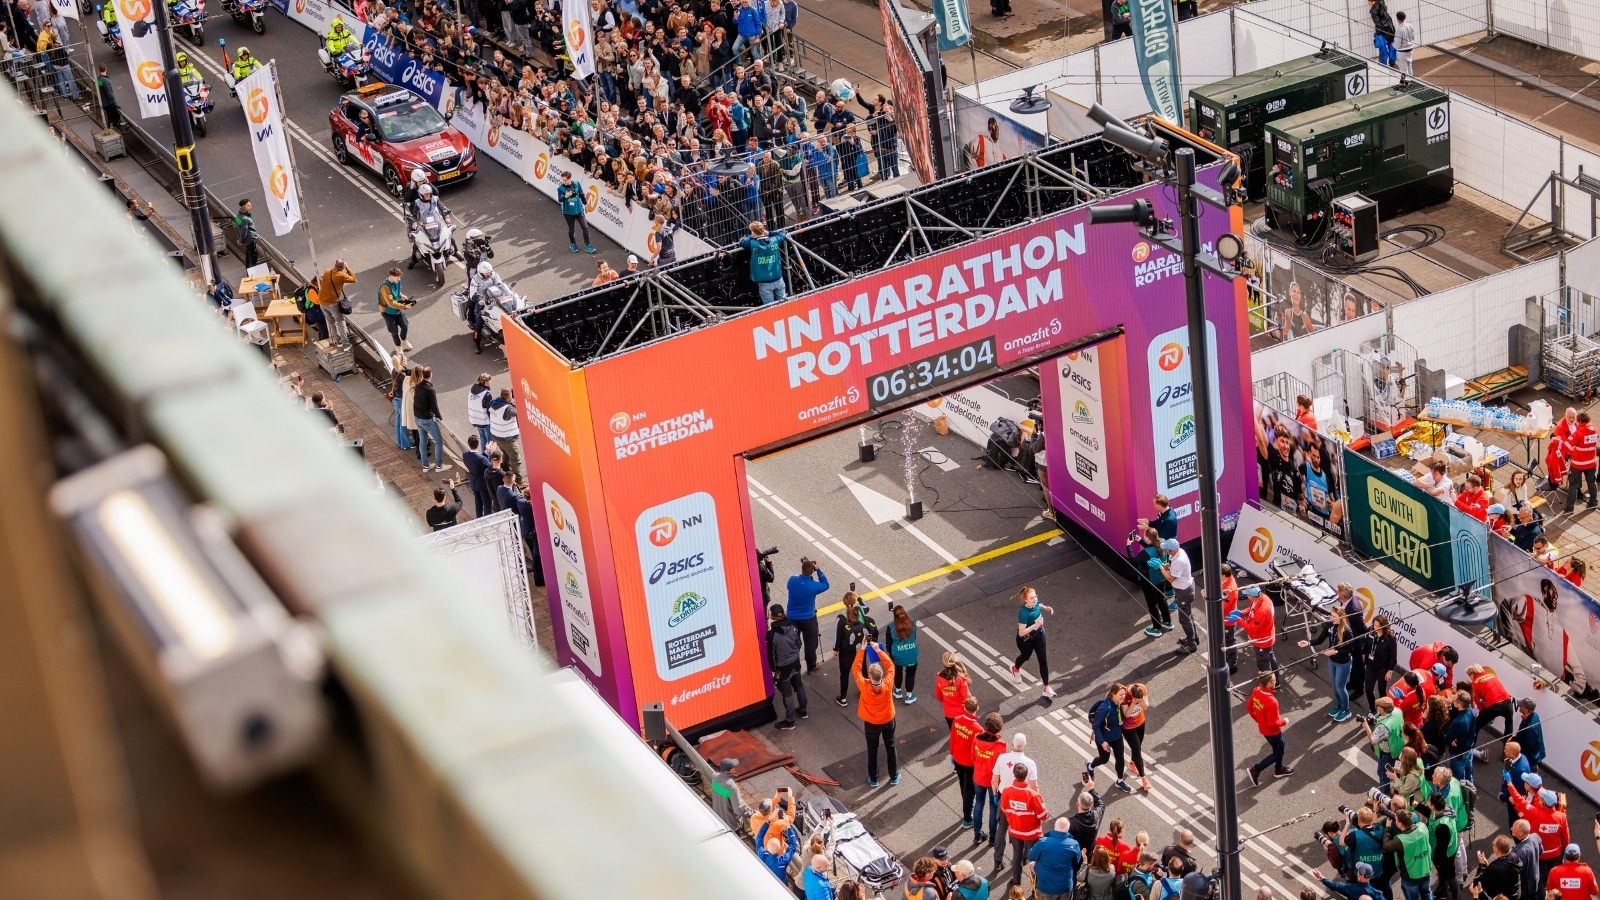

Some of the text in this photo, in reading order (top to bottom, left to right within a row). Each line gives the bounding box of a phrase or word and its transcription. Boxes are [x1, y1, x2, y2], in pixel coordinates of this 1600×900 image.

[412, 70, 436, 96] asics
[752, 222, 1087, 361] NN MARATHON
[786, 268, 1064, 389] ROTTERDAM
[1003, 326, 1050, 351] amazfit
[871, 340, 994, 402] 06:34:04
[1071, 370, 1092, 391] asics
[1171, 381, 1192, 399] asi
[524, 398, 567, 441] MARATHON
[632, 411, 647, 422] NN
[797, 395, 848, 421] amazfit
[945, 400, 990, 429] nederlanden
[526, 410, 572, 457] ROTTERDAM
[613, 409, 705, 449] MARATHON
[615, 417, 714, 461] ROTTERDAM
[1168, 460, 1195, 476] MAKE IT
[1169, 468, 1197, 481] HAPPEN.
[1373, 487, 1414, 524] GO WITH
[682, 514, 703, 529] NN
[560, 540, 578, 564] asics
[1369, 513, 1432, 579] GOLAZO
[667, 552, 705, 576] asics
[682, 597, 697, 612] AA
[1378, 606, 1417, 636] nationale
[668, 628, 714, 649] ROTTERDAM.
[669, 642, 690, 655] MAKE
[670, 646, 702, 662] HAPPEN.
[670, 674, 732, 706] #demooiste
[956, 729, 969, 740] Team
[977, 751, 991, 760] Team
